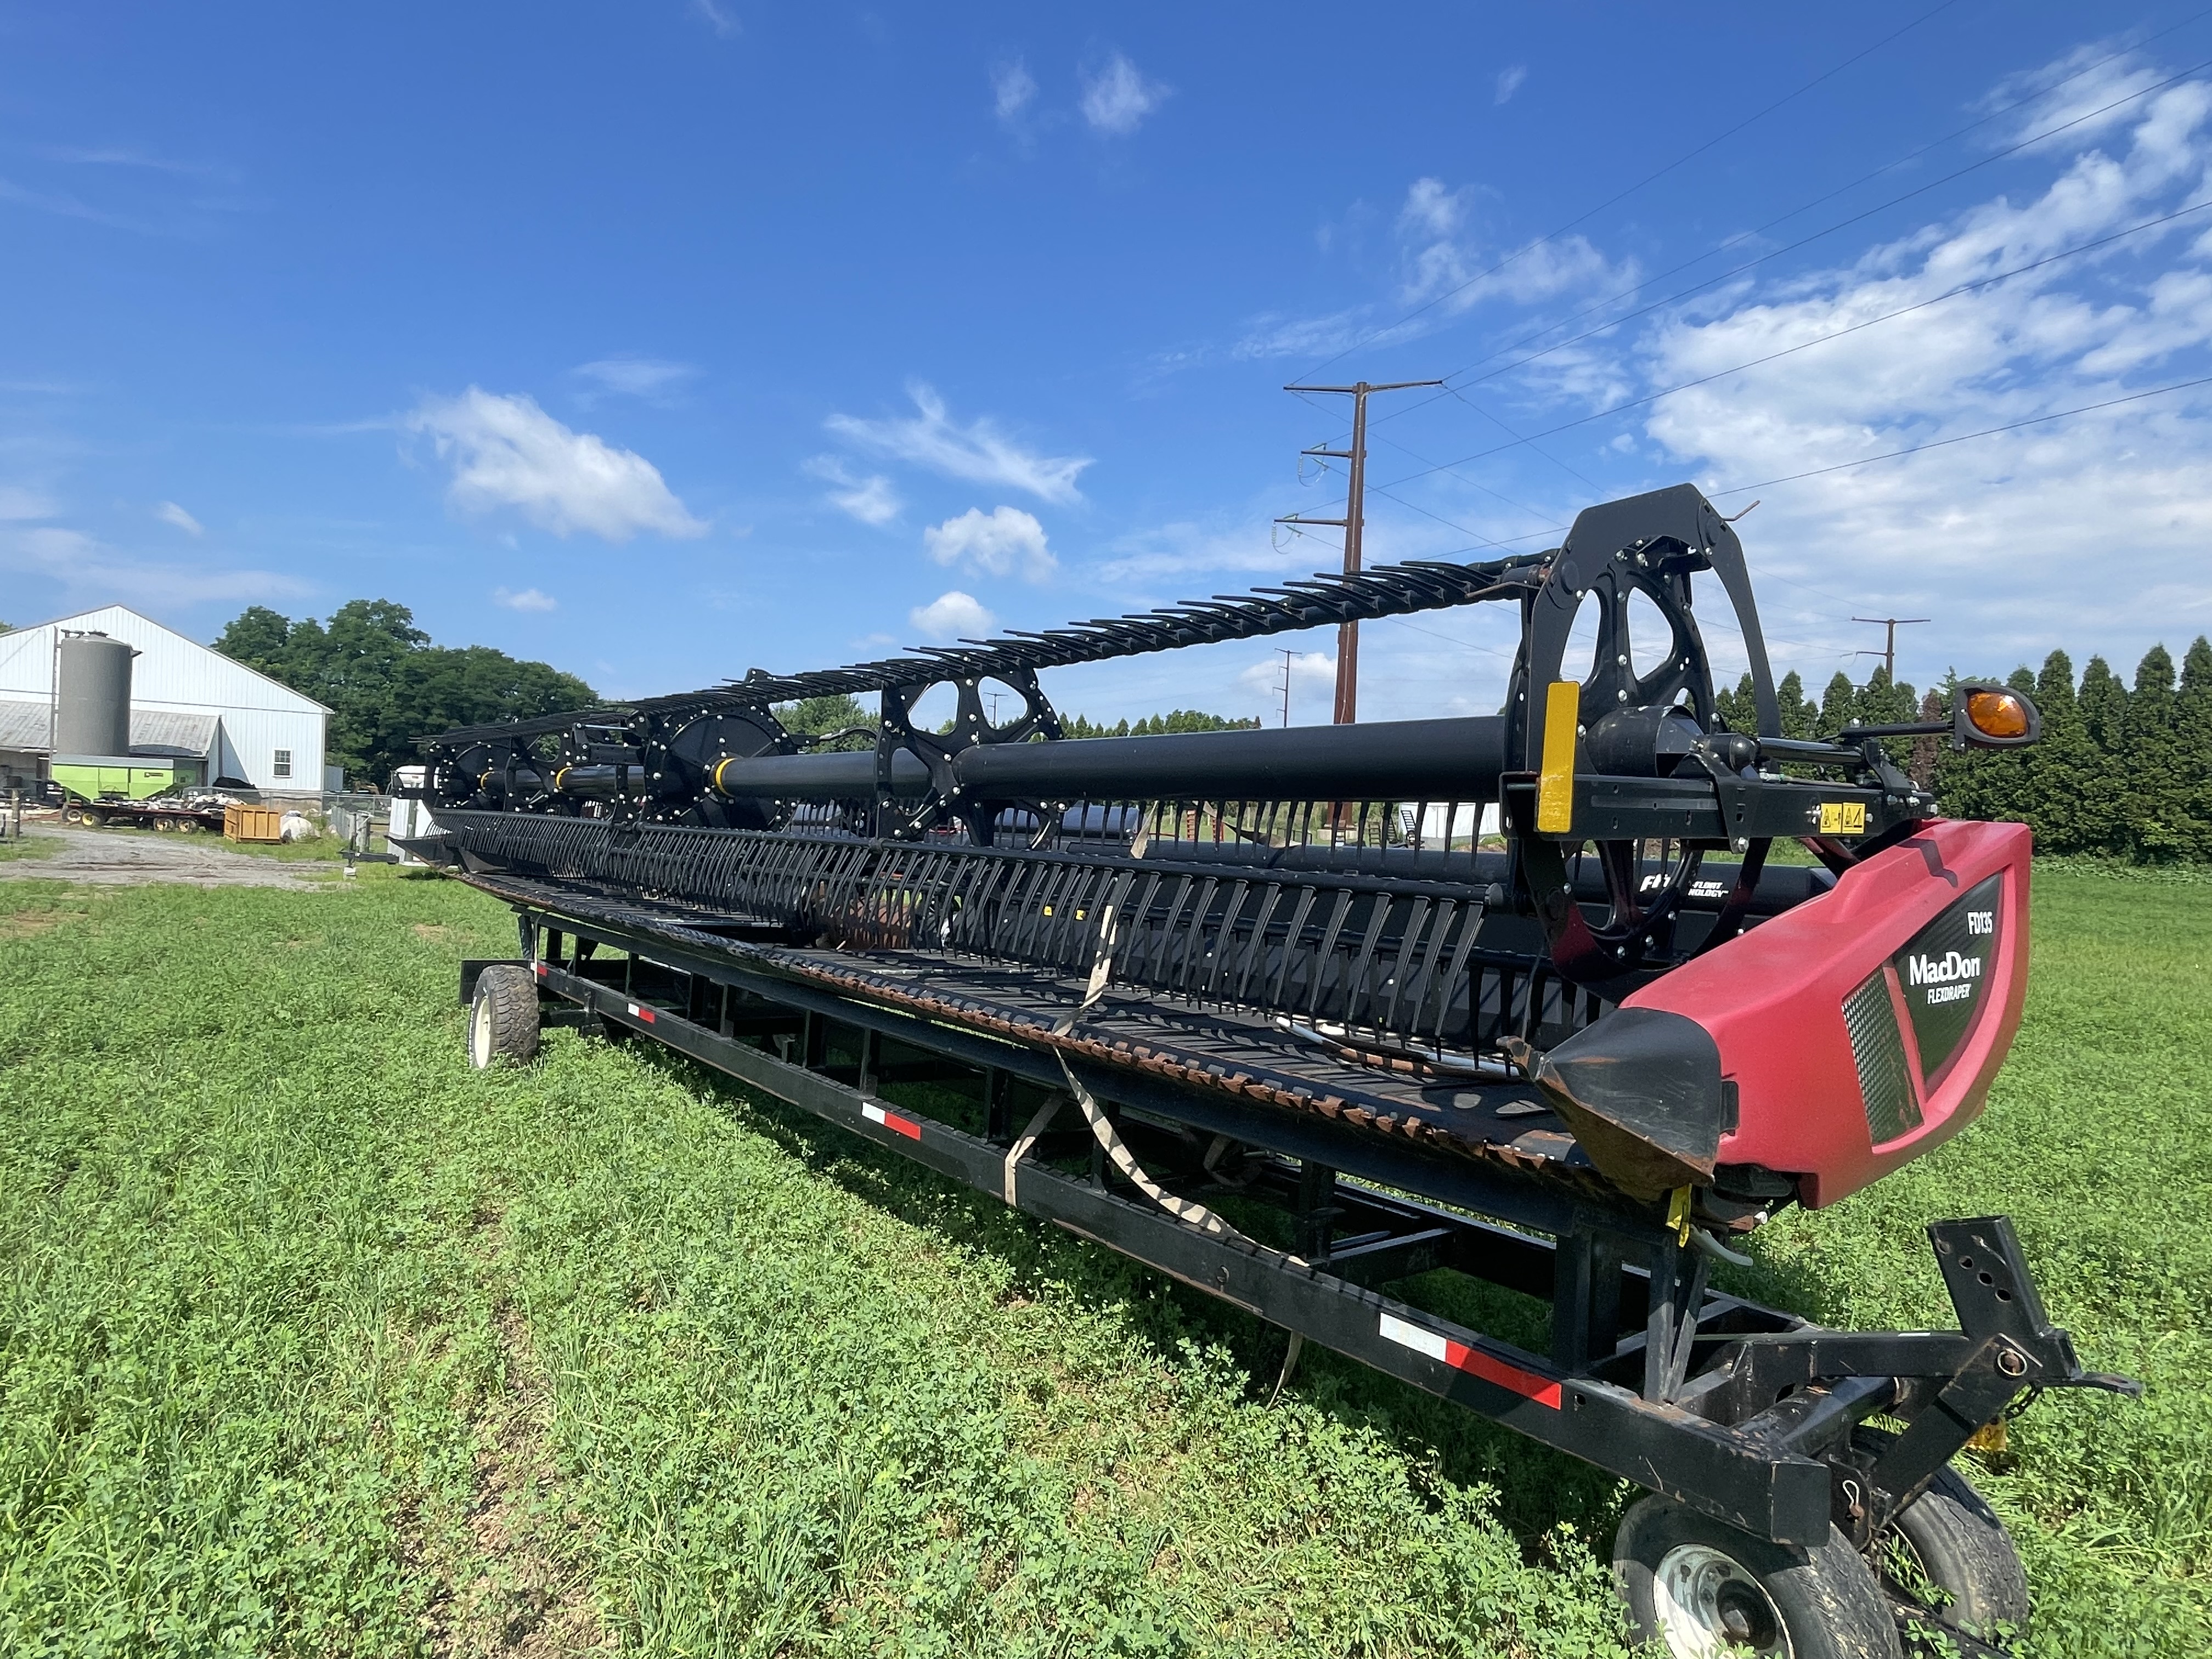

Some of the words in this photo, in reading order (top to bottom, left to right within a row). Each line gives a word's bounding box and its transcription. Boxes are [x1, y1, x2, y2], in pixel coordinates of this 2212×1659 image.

[1967, 911, 1993, 935] FD135
[1909, 951, 1981, 986] MacDon
[1927, 984, 1971, 1005] FLEXDRAPER
